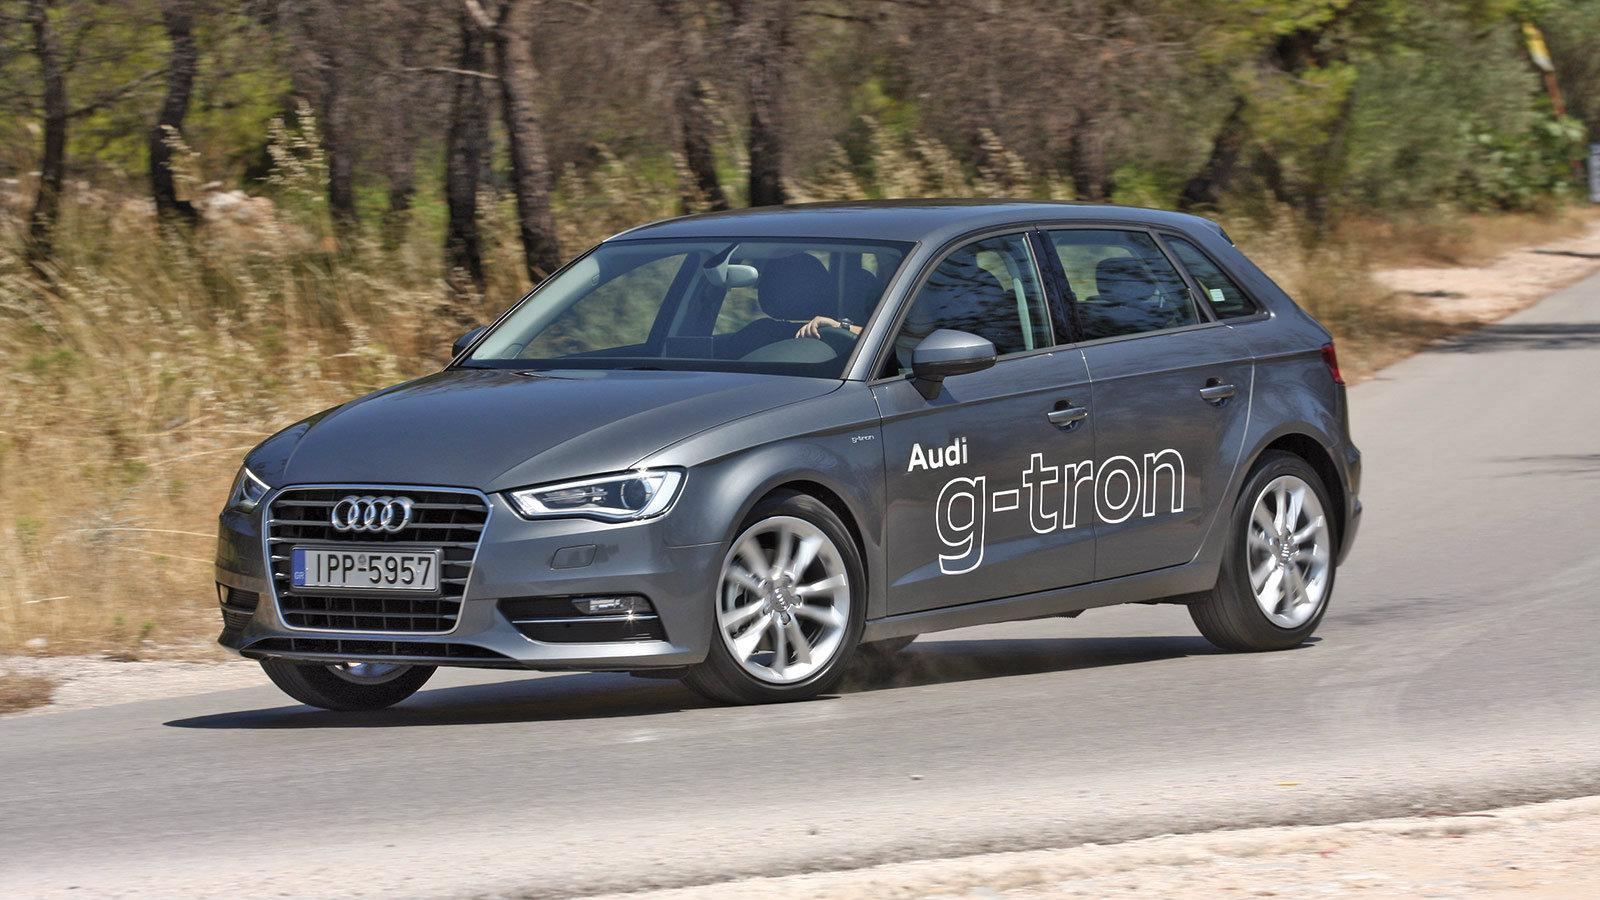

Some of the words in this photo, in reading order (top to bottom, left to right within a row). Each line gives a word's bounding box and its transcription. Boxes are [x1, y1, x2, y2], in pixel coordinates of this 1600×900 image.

[851, 435, 875, 443] g-tron
[907, 436, 968, 472] Audi
[935, 448, 1186, 575] g-tron
[317, 553, 432, 586] IPP-5957
